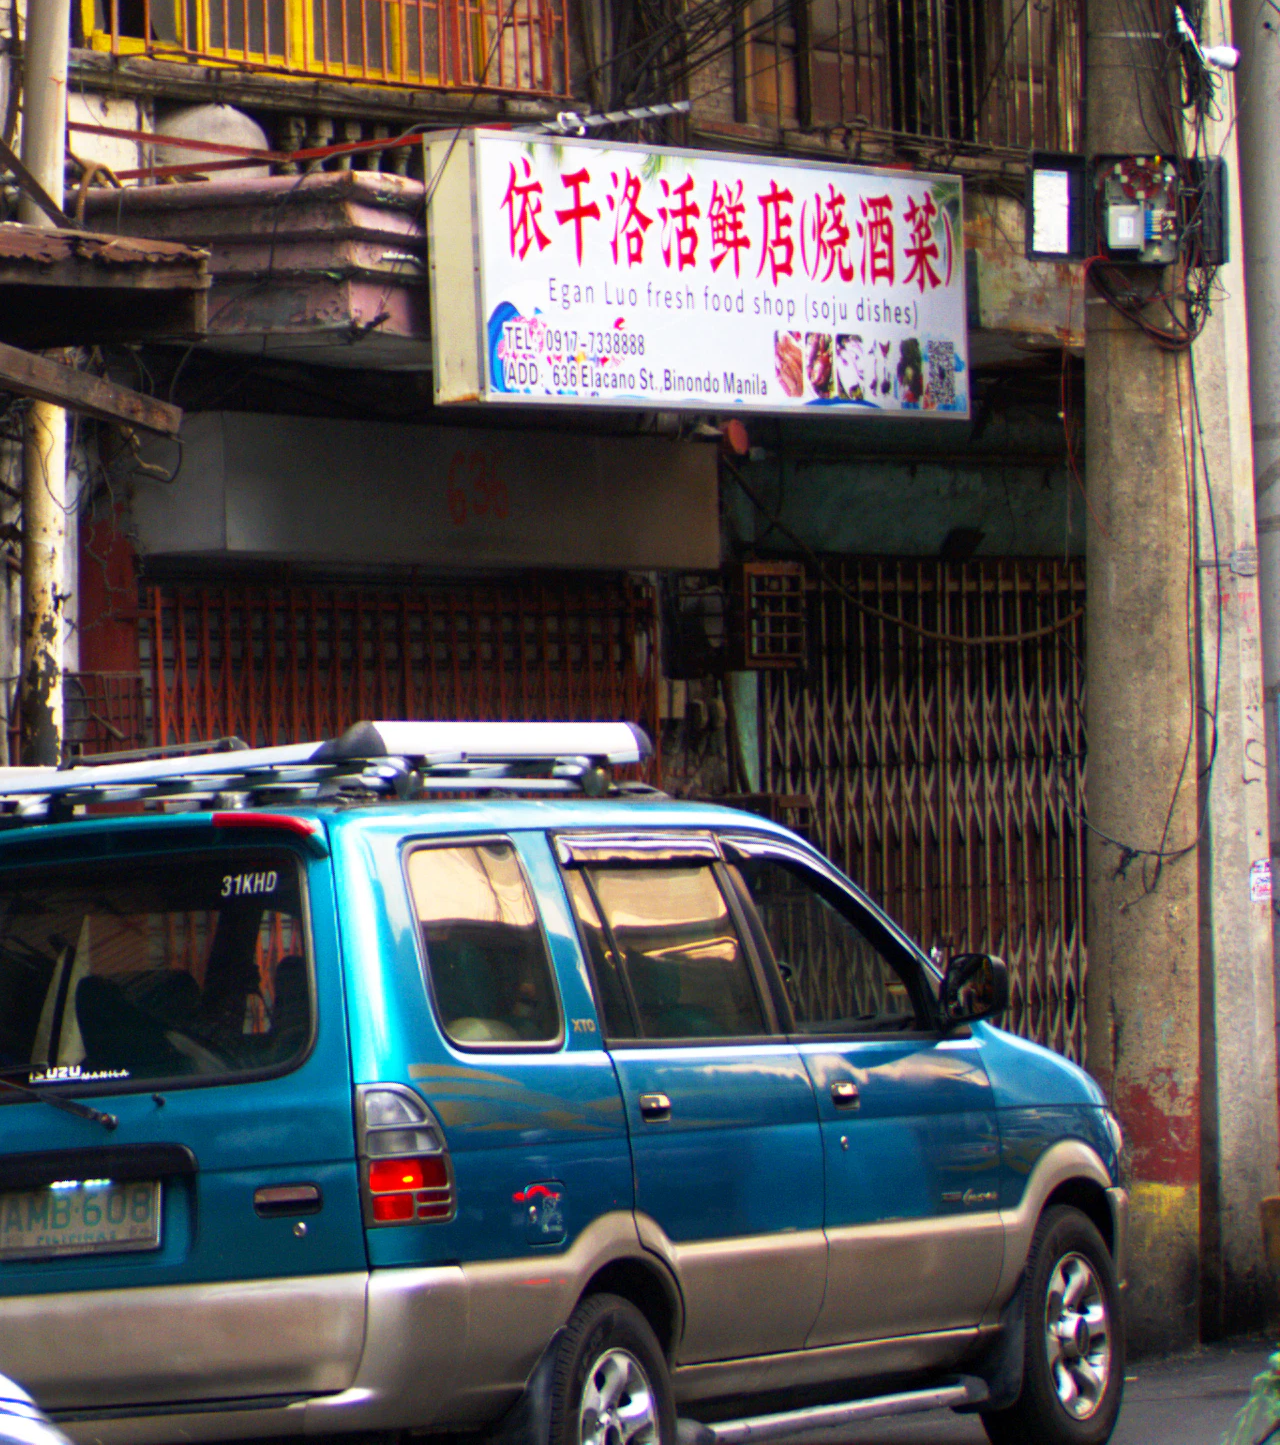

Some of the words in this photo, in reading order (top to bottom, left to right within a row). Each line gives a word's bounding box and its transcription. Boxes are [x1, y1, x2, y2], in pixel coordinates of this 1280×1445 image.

[549, 277, 594, 310] Egan
[604, 281, 638, 306] Luo
[647, 281, 695, 309] fresh
[704, 285, 744, 314] food
[753, 290, 796, 323] shop
[804, 293, 847, 326] (soju
[856, 297, 918, 330] dishes)
[552, 364, 577, 387] 636
[581, 365, 635, 390] Elacano
[723, 371, 768, 395] Manila
[220, 870, 277, 897] 31KHD
